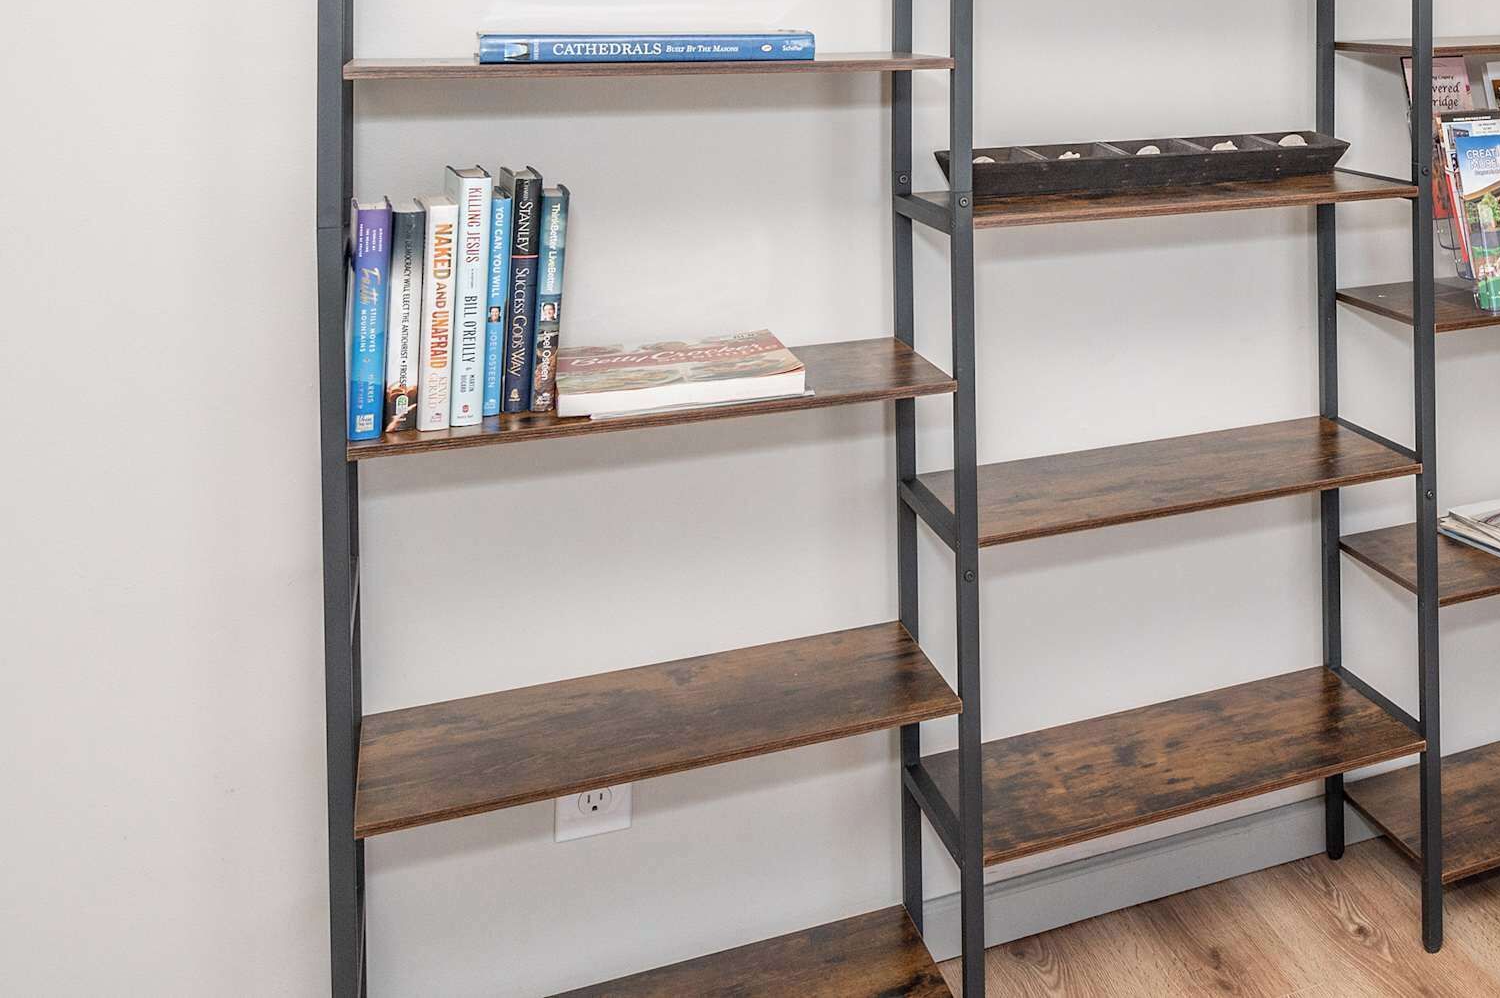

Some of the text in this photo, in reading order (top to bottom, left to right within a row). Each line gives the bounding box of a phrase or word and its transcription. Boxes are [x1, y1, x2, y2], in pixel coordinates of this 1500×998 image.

[553, 43, 662, 55] CATHEDRALS
[1432, 82, 1460, 93] vered
[1432, 95, 1460, 110] ridge
[467, 187, 482, 263] KILLING JESUS
[518, 202, 533, 252] STANLEY
[491, 206, 505, 298] YOU CAN, YOU WILL
[402, 293, 410, 311] ELECT
[431, 224, 453, 369] NAKED AND UNAFRAID
[465, 295, 478, 318] BILL
[514, 267, 529, 314] SUCCESS
[360, 309, 368, 352] MOUNTAINS
[401, 312, 409, 323] THE
[400, 324, 409, 359] ANTICHRIST
[462, 320, 477, 363] O'REILLY
[488, 330, 498, 388] JOEL OSTEEN
[508, 348, 526, 377] WAY
[541, 330, 551, 381] Joel Osteen
